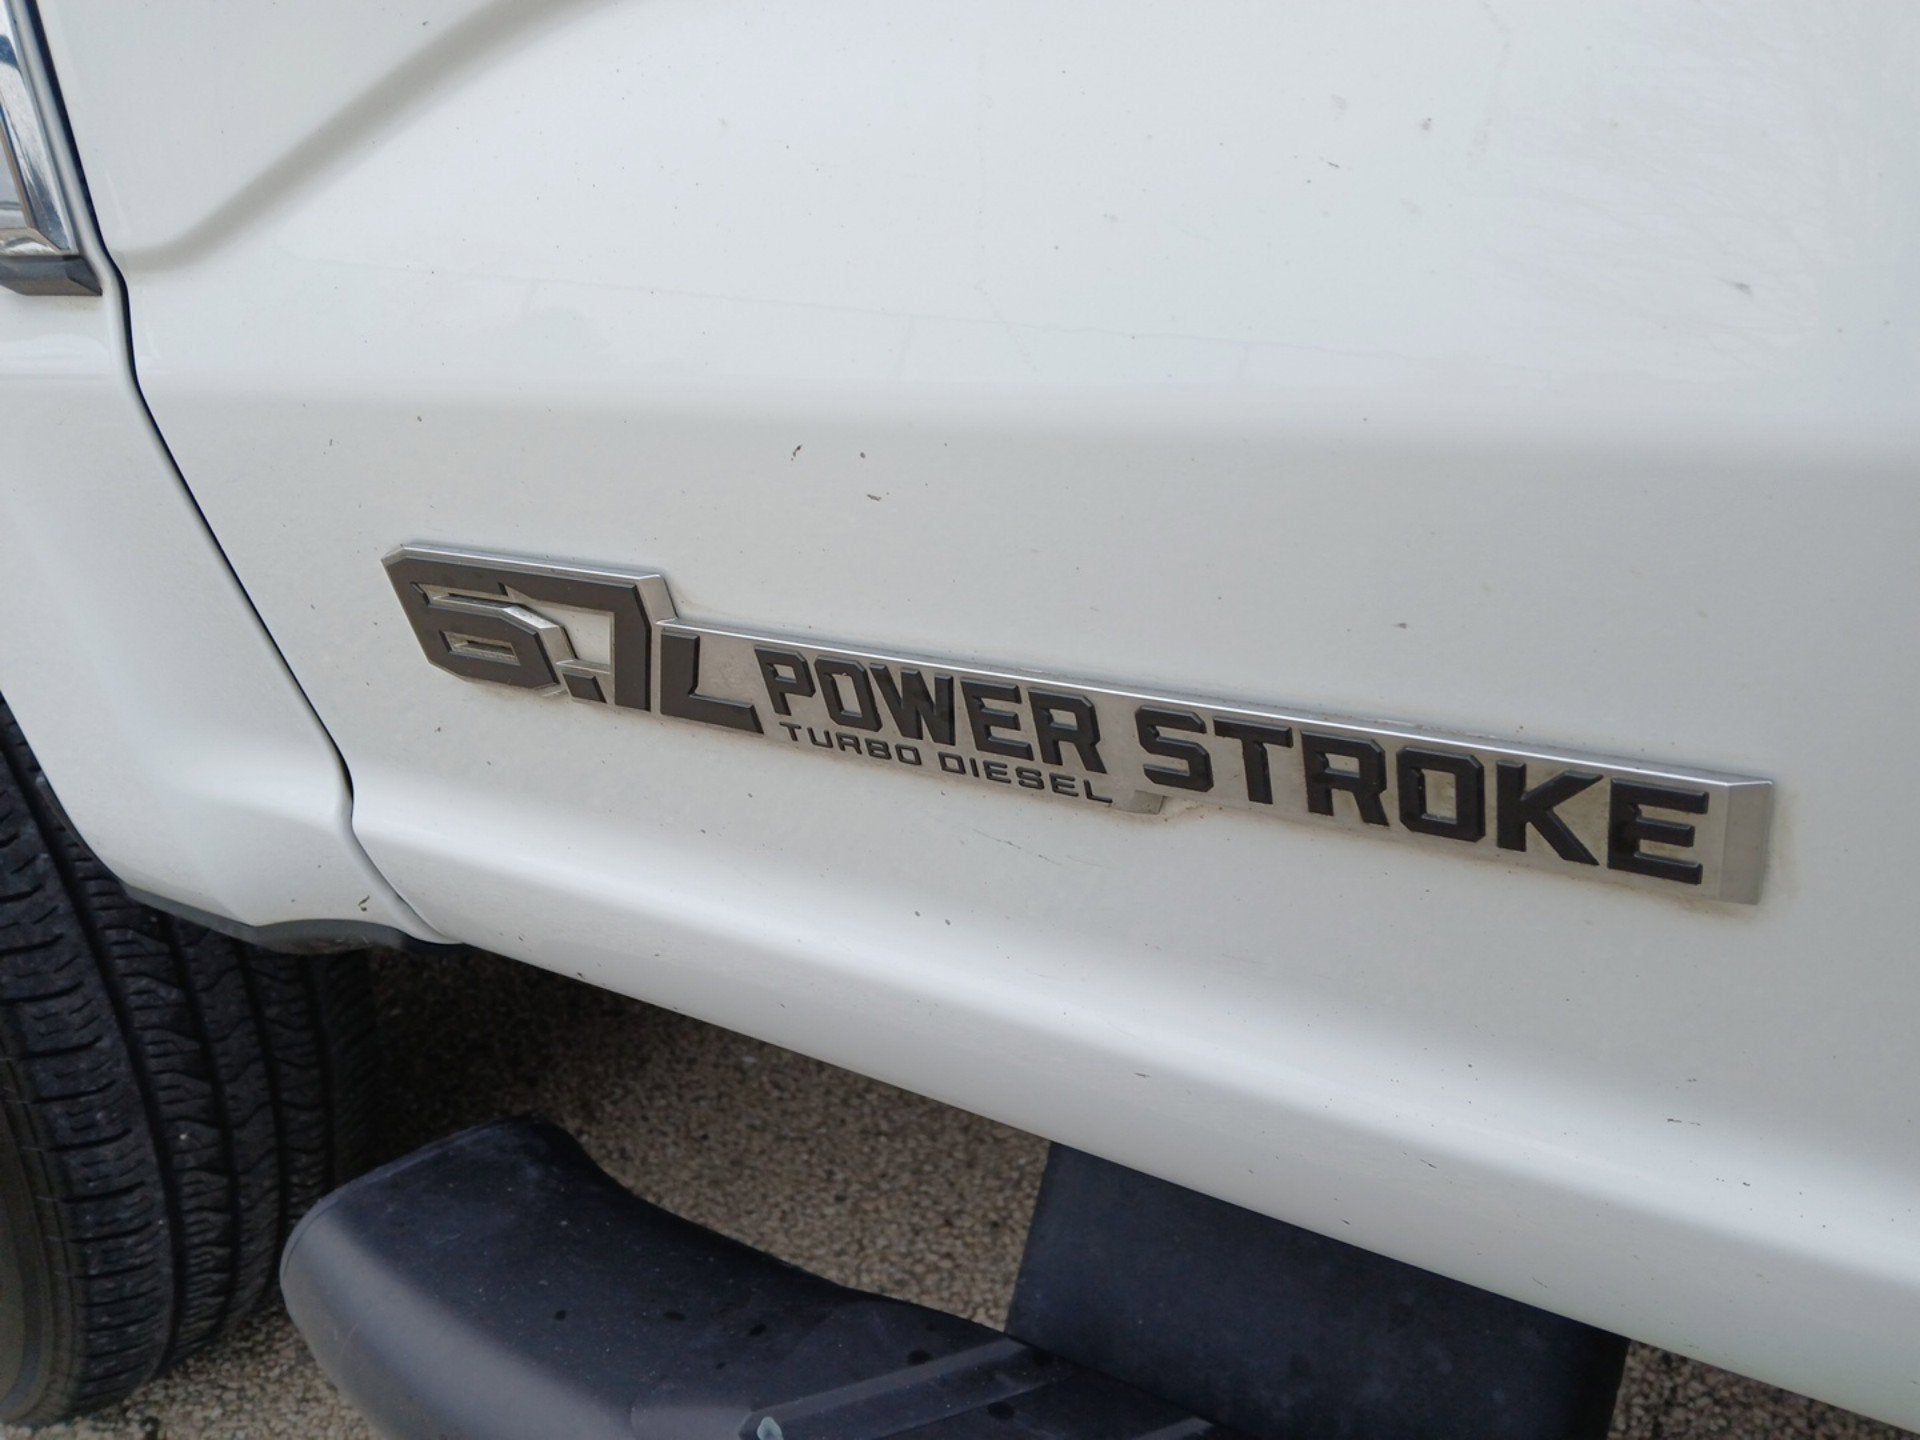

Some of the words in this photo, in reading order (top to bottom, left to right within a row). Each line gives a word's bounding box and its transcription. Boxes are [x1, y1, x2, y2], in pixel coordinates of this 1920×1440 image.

[386, 550, 763, 735] 6.7L
[754, 645, 1107, 775] POWER
[1135, 705, 1709, 885] STROKE
[779, 721, 922, 766] TURBO
[938, 751, 1113, 804] DIESEL
